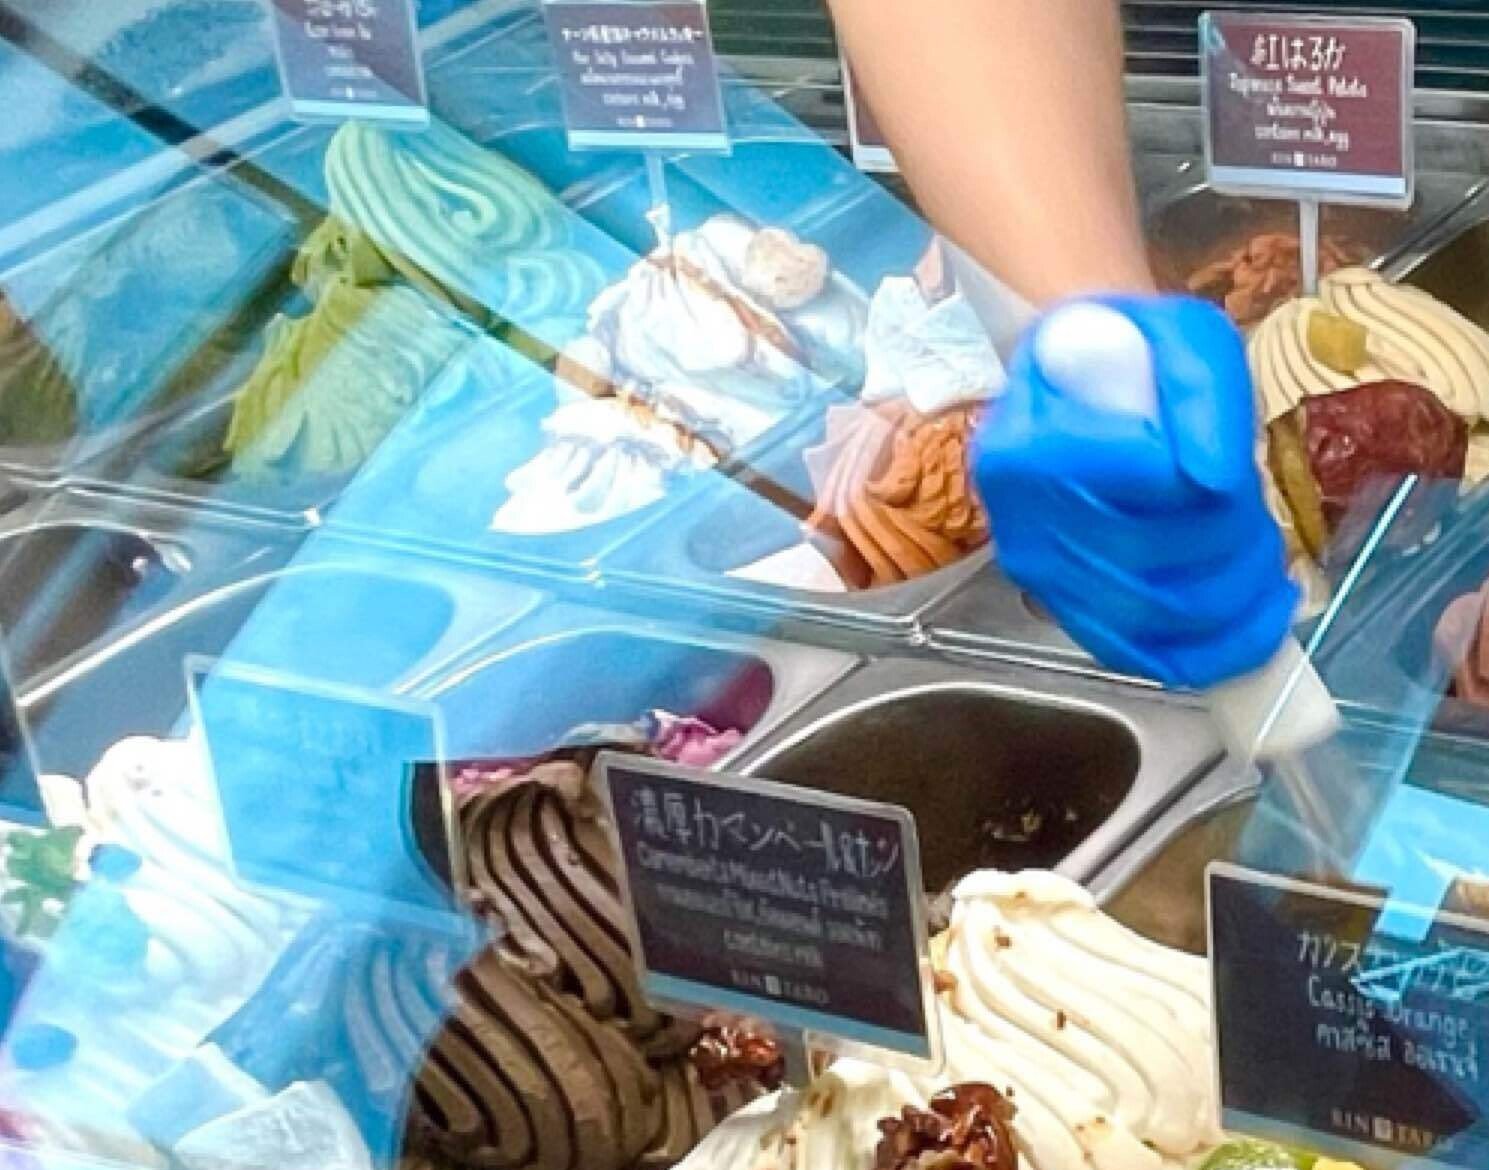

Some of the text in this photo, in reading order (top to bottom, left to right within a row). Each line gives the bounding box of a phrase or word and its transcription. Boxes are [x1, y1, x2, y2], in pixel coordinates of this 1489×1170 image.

[1250, 33, 1347, 71] 紅はるか
[1331, 1107, 1371, 1132] RIN
